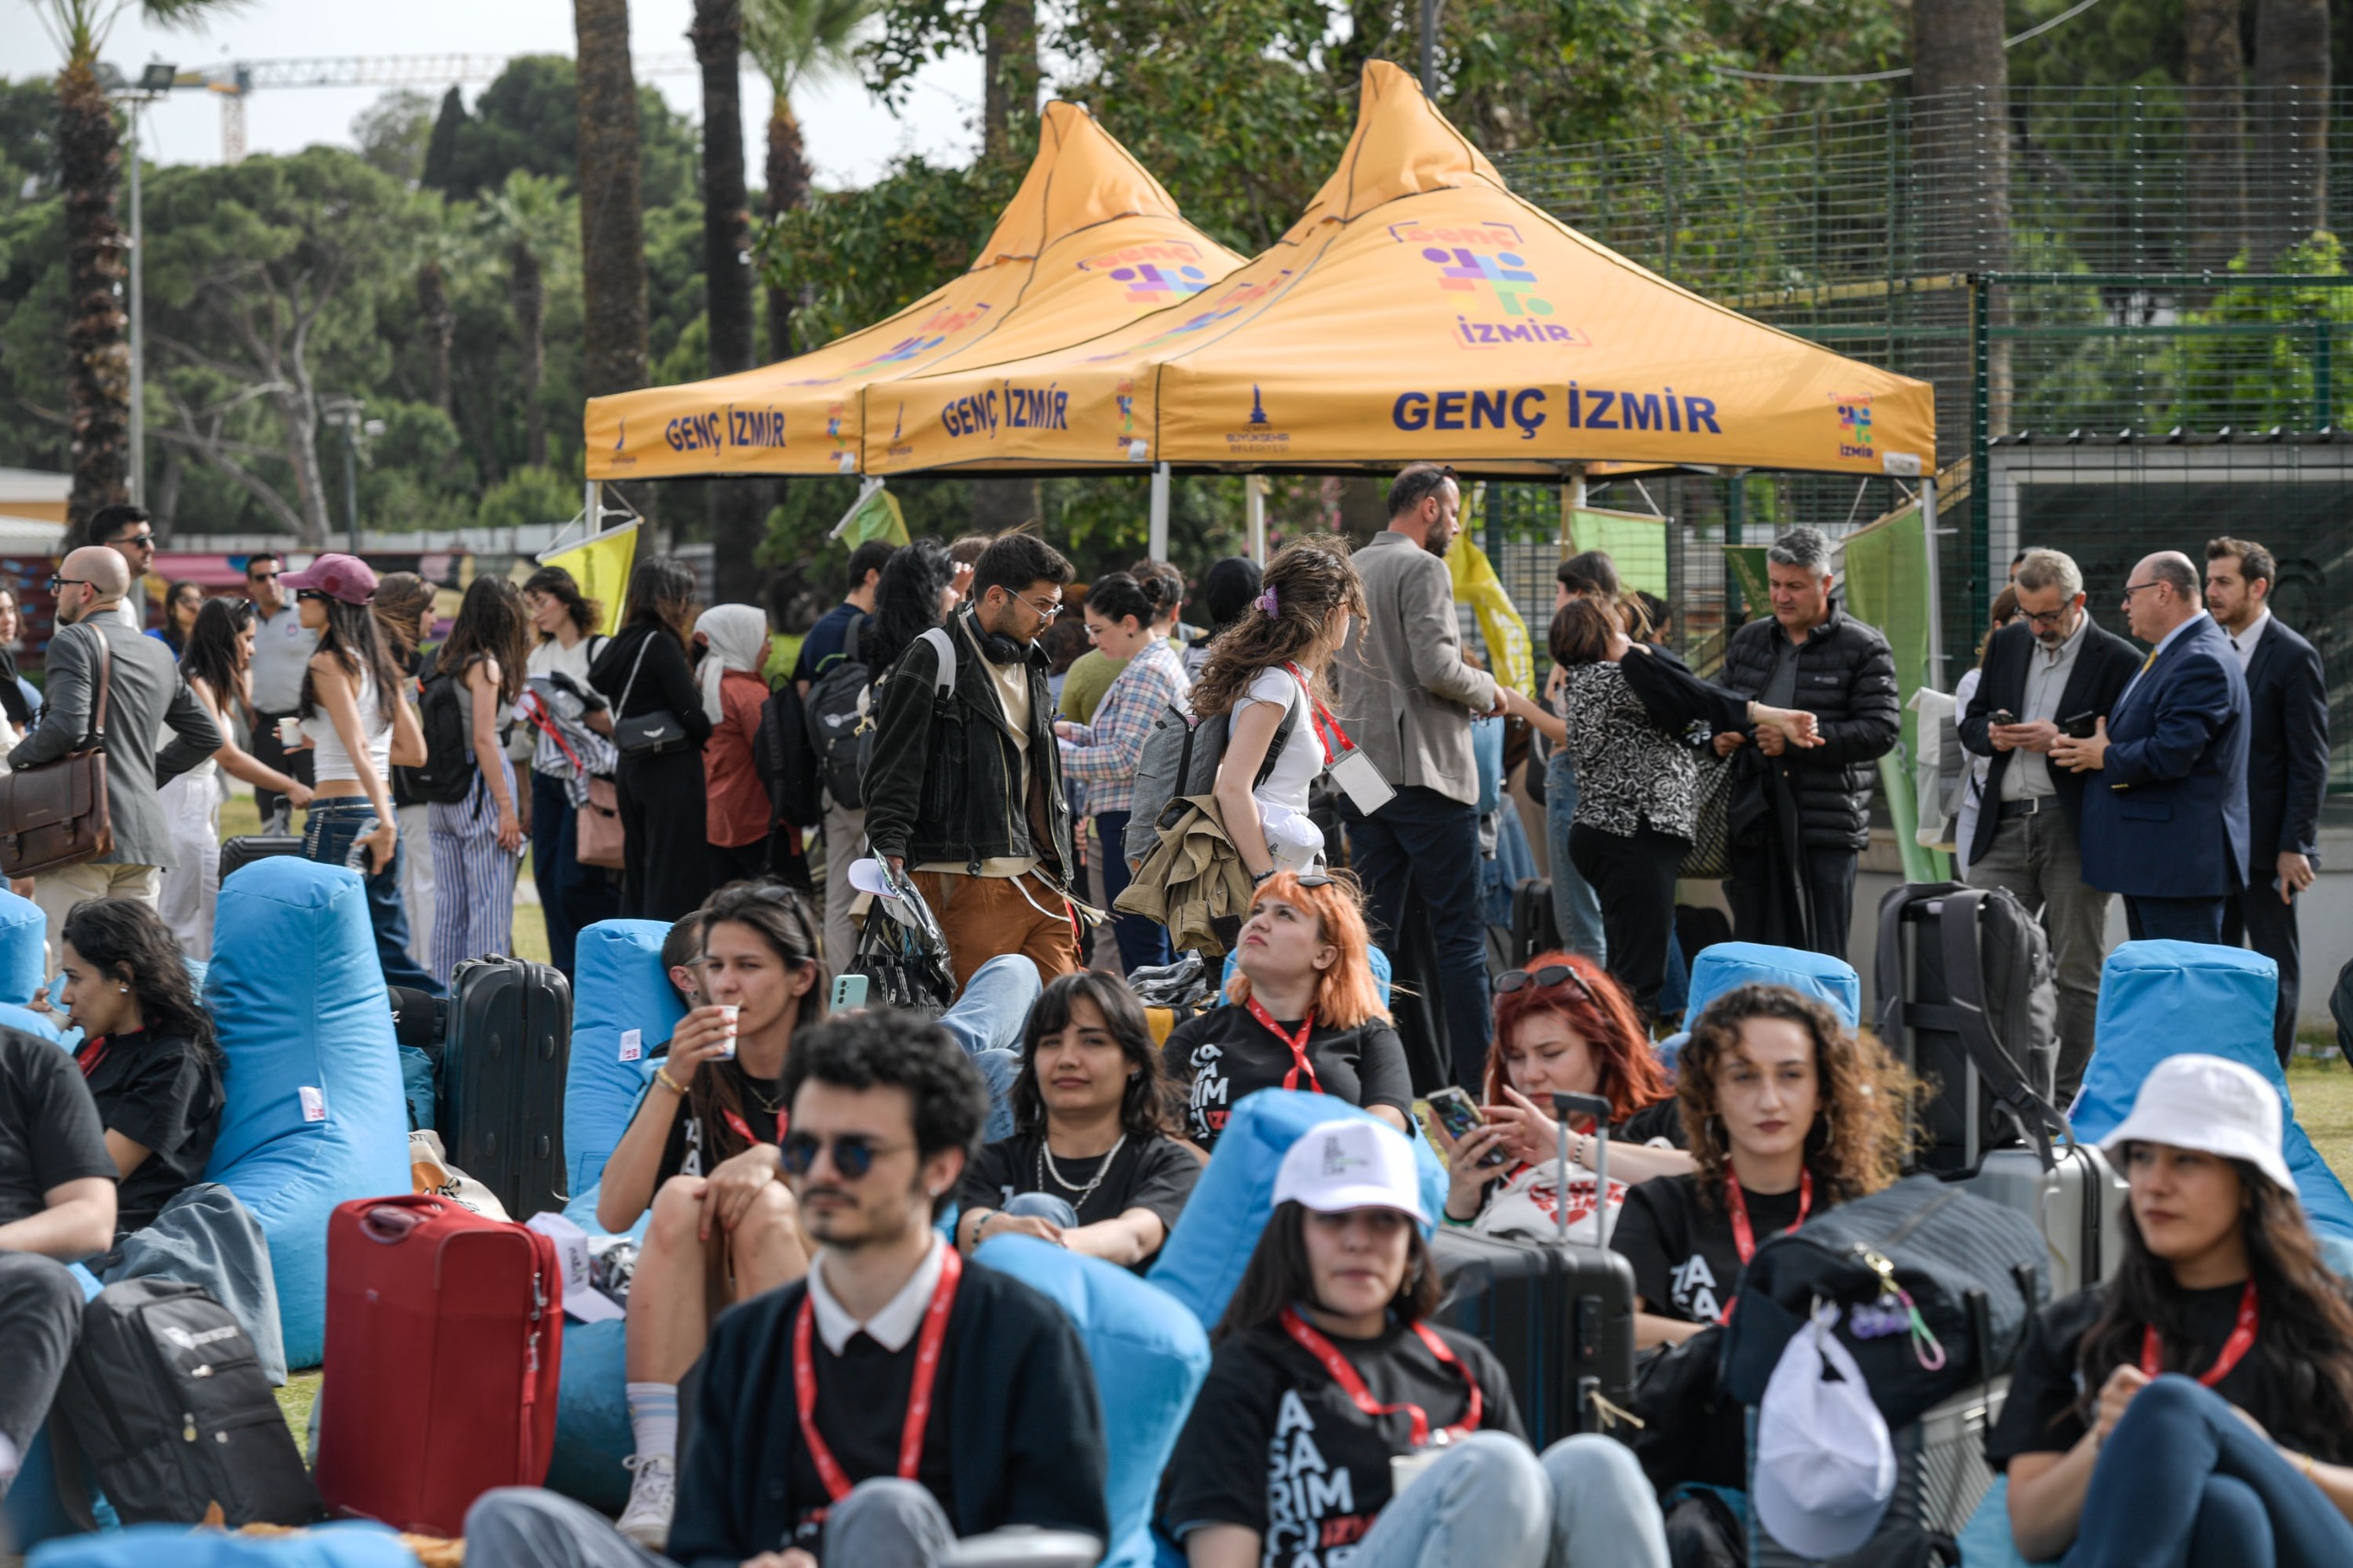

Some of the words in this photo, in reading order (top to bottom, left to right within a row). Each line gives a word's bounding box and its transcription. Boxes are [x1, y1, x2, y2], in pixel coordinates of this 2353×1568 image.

[1457, 314, 1575, 344] İZMİR
[665, 412, 722, 457] GENÇ
[727, 403, 787, 449] İZMİR
[940, 389, 999, 439] GENÇ
[1004, 379, 1069, 431] İZMİR
[1392, 387, 1548, 440] GENÇ
[1567, 380, 1723, 435] İZMİR
[1267, 1467, 1355, 1526] RIM
